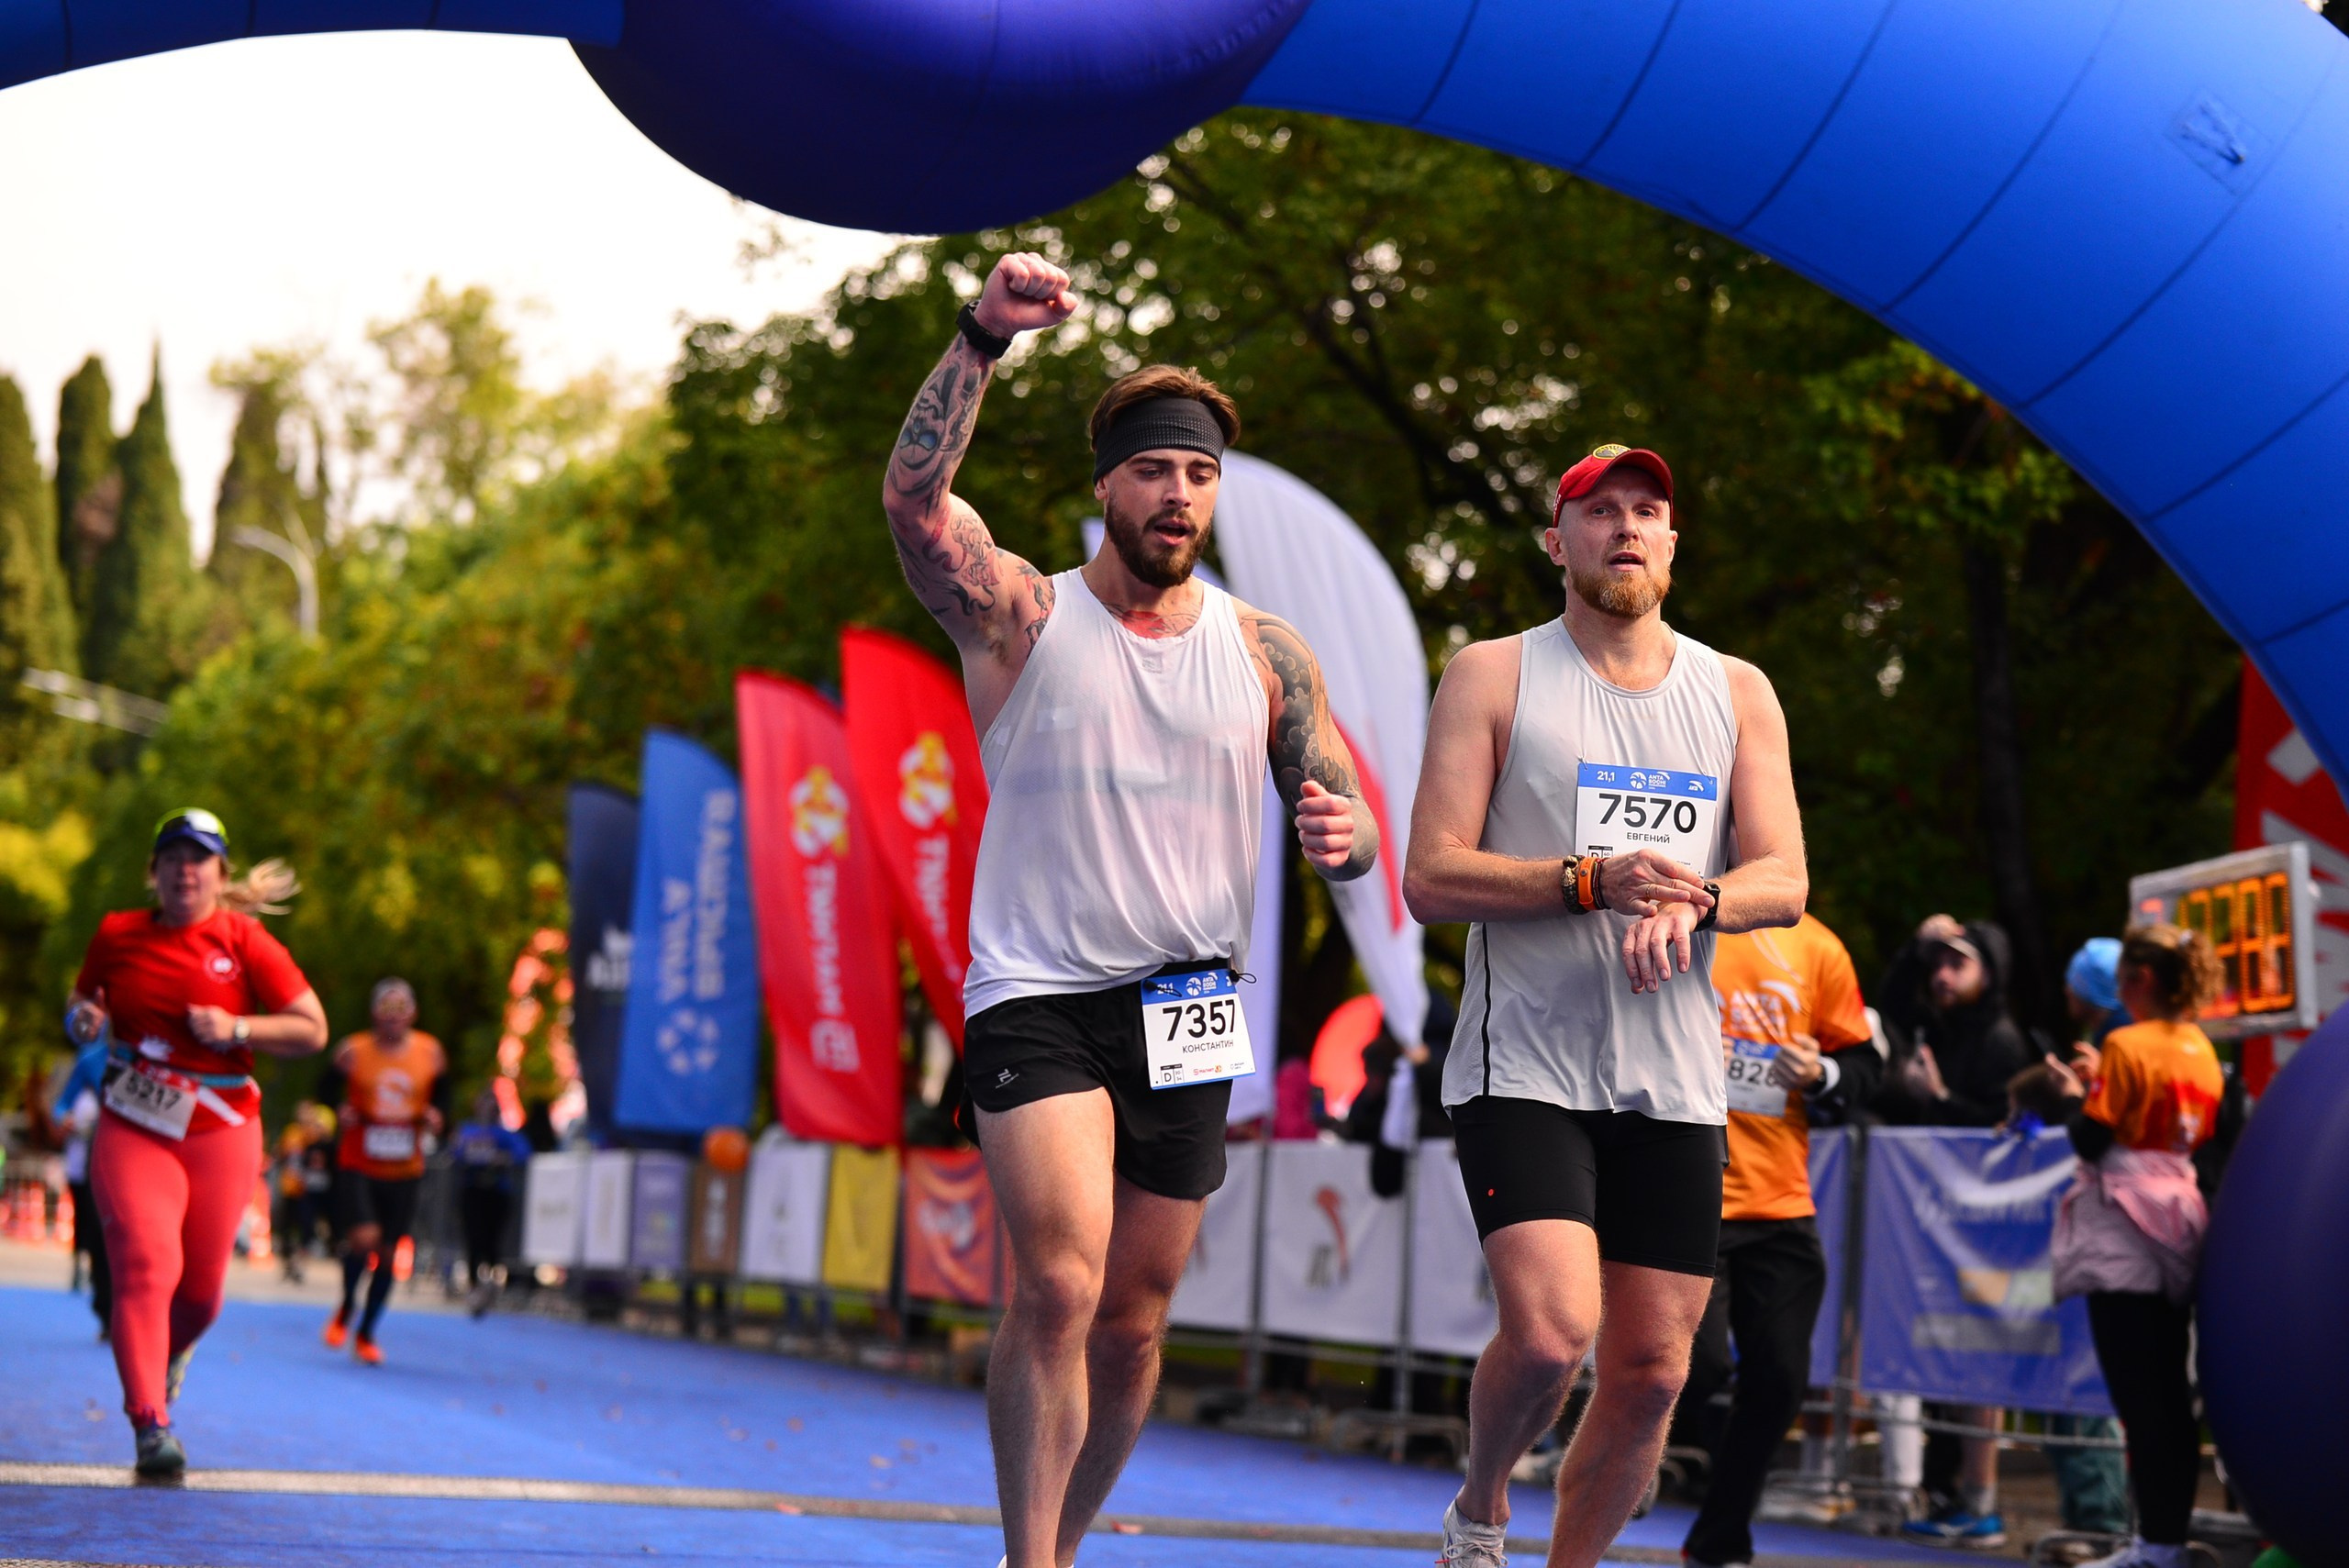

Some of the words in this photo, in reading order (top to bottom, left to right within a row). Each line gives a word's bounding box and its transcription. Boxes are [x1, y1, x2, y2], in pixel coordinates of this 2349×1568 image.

[1597, 770, 1615, 783] 21,1
[1598, 793, 1697, 834] 7570
[1626, 831, 1671, 844] ЕВГЕНИЙ
[1163, 999, 1235, 1042] 7357
[1182, 1040, 1234, 1054] КОНСТАНТИН
[1163, 1073, 1172, 1083] D
